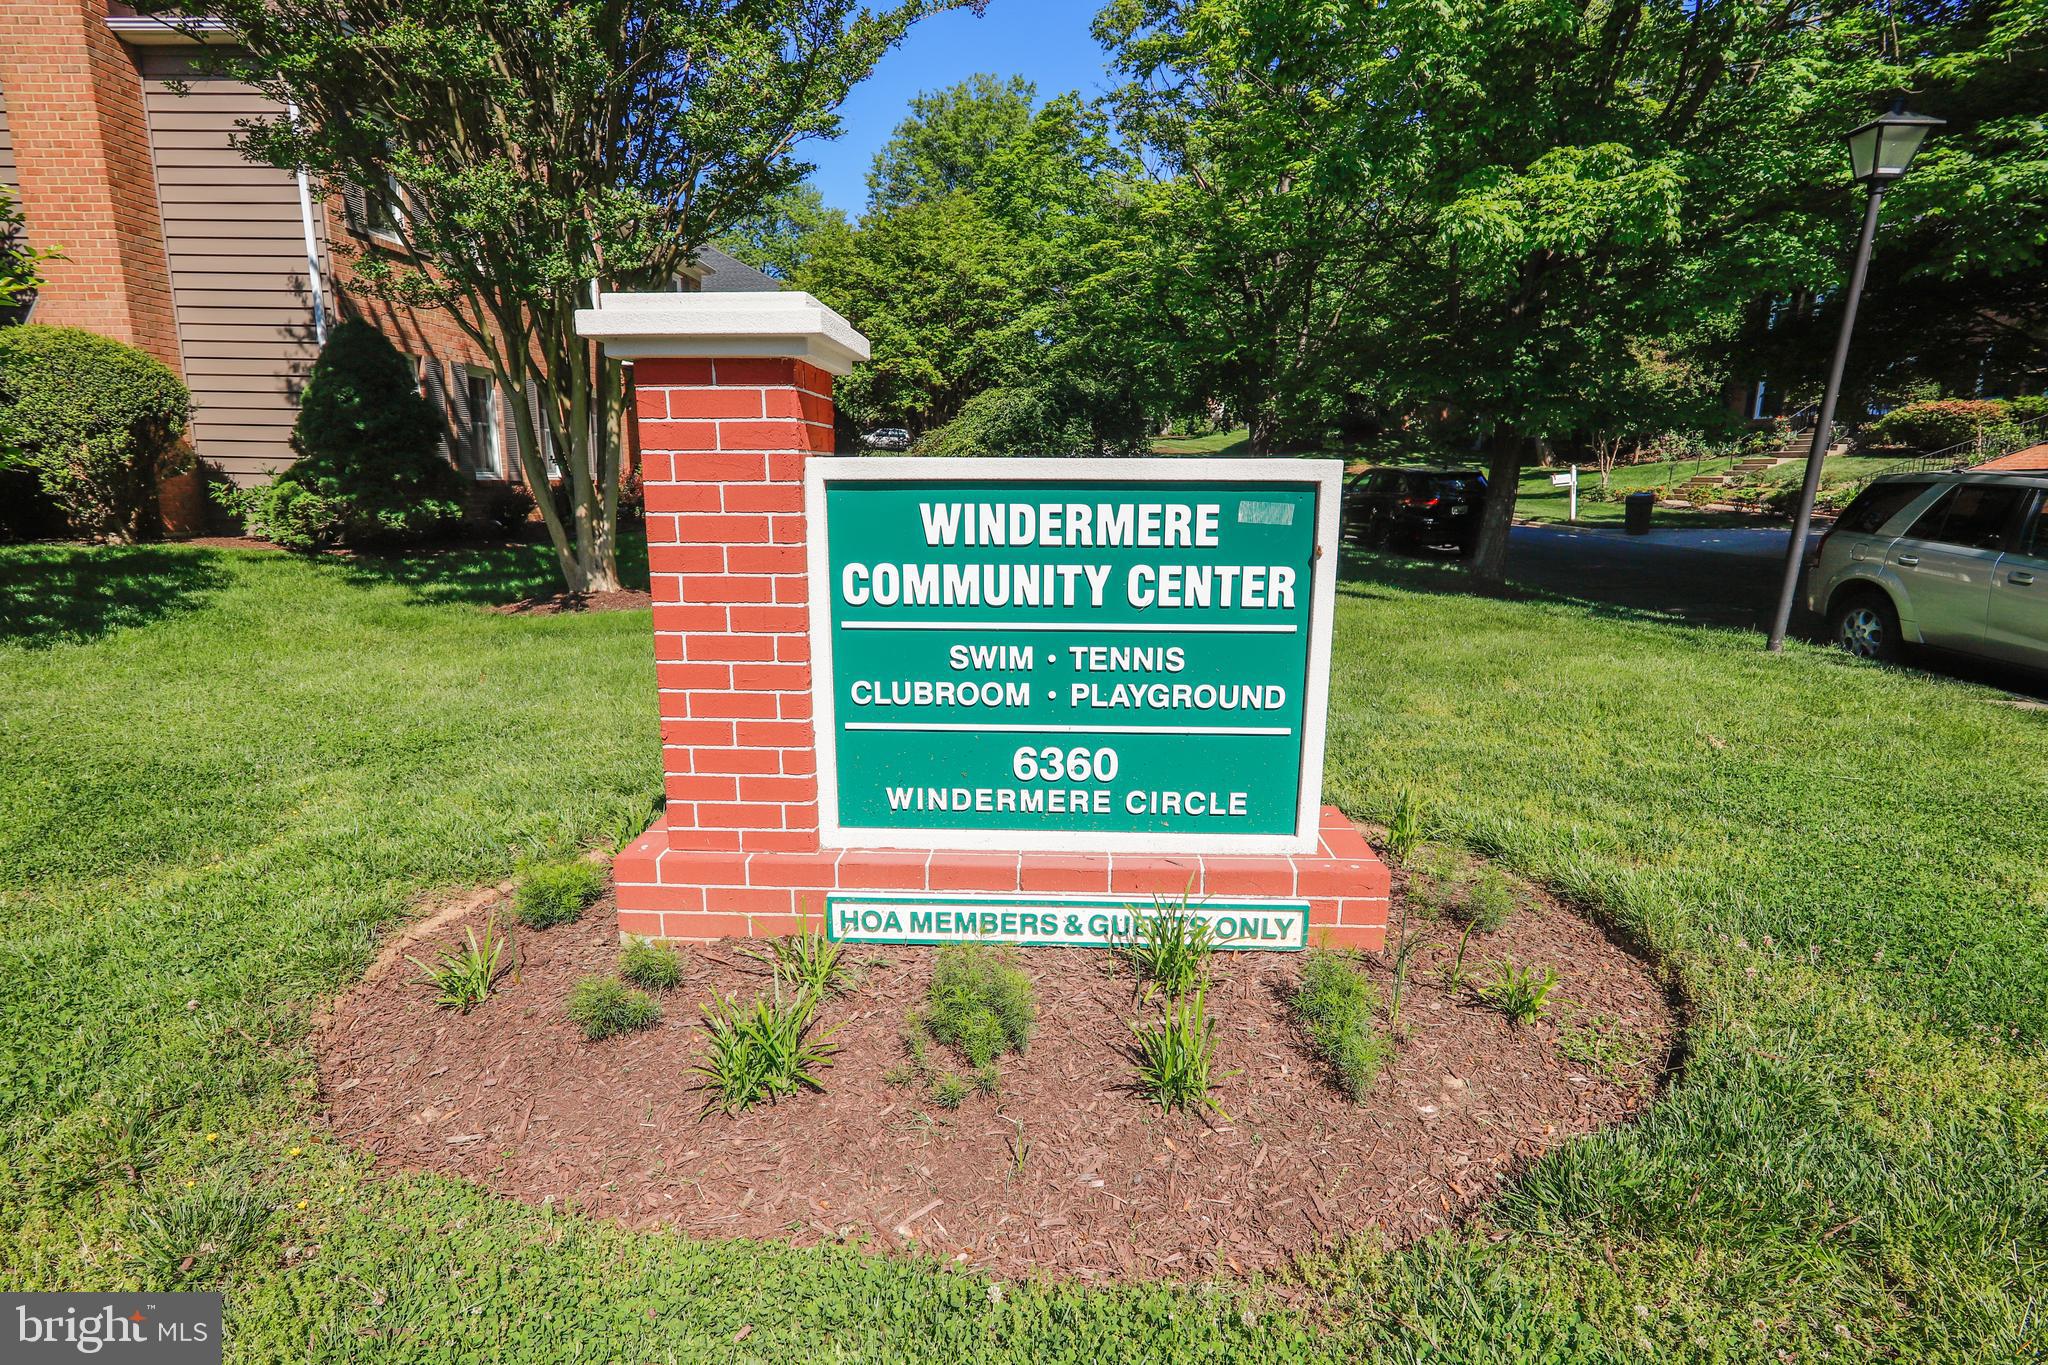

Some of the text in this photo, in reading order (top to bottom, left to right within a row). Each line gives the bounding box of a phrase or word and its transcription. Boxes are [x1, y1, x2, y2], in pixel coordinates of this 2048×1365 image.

[919, 502, 1220, 547] WINDERMERE
[842, 562, 1296, 609] COMMUNITY CENTER
[949, 645, 1185, 672] SWIM TENNIS
[850, 680, 1286, 710] CLUBROOM PLAYGROUND
[1013, 746, 1119, 782] 6360
[885, 787, 1248, 815] WINDERMERE CIRCLE
[840, 910, 1294, 940] HOA MEMBERS & GUES ONLY
